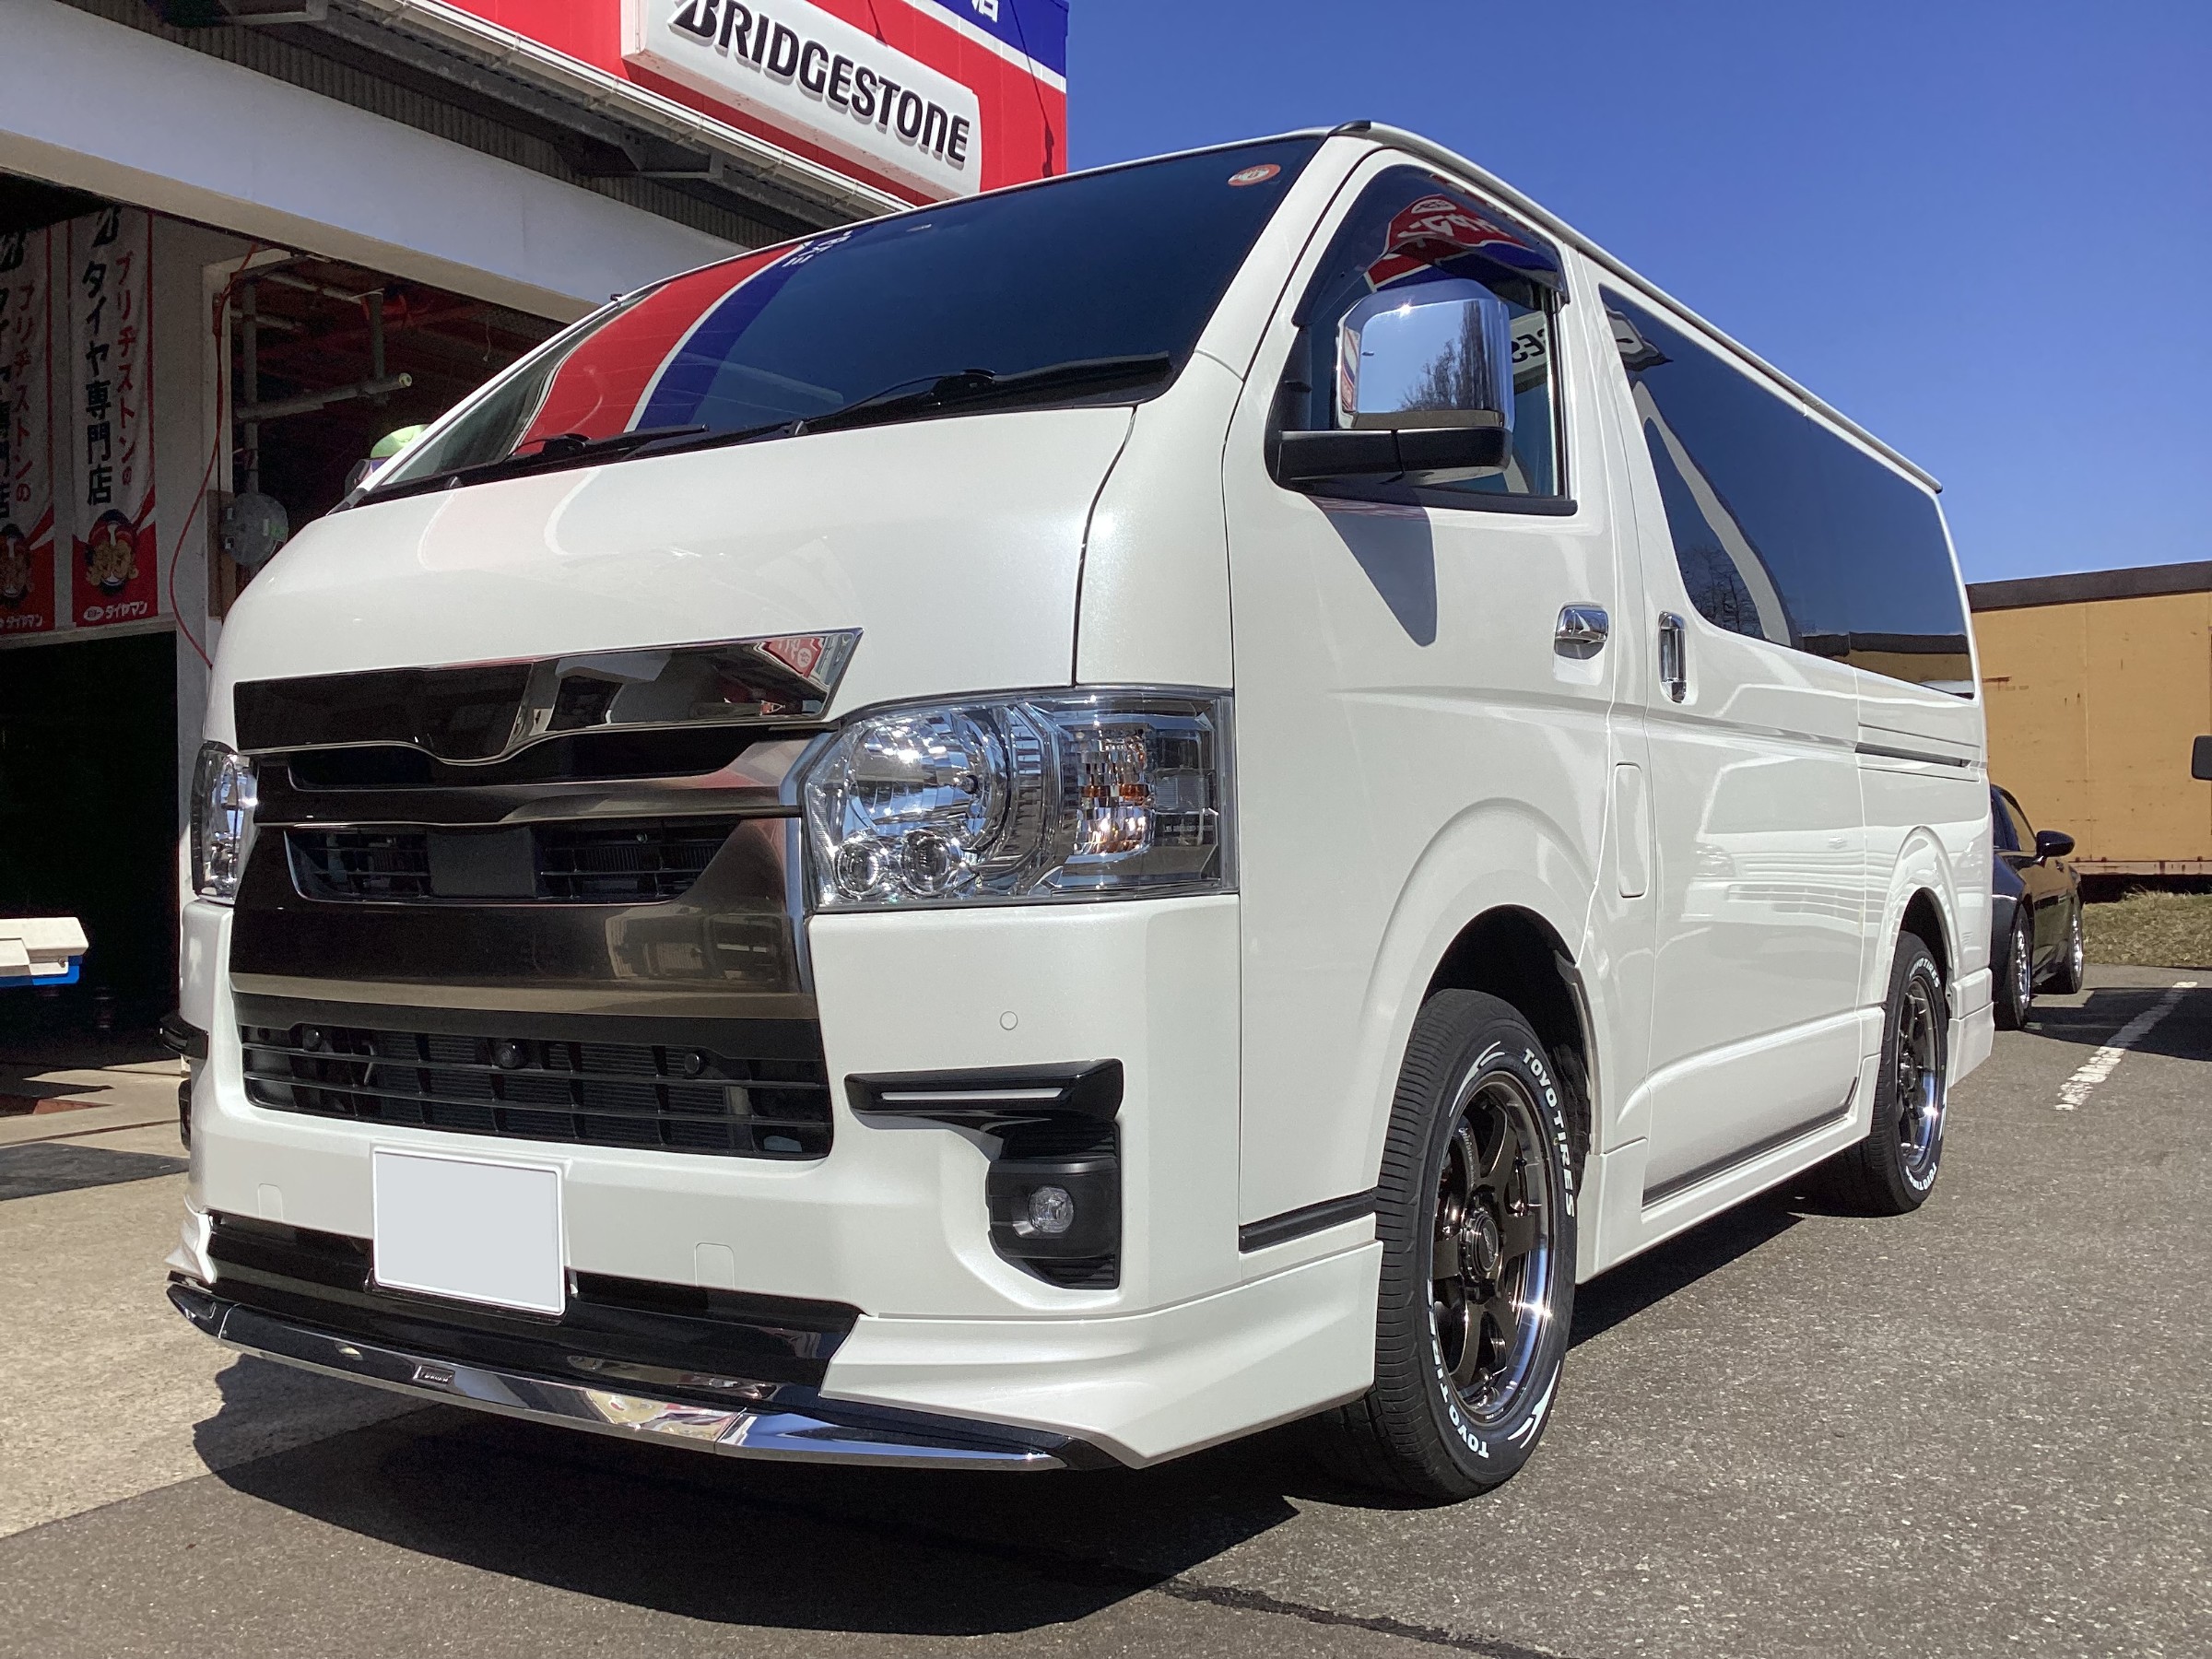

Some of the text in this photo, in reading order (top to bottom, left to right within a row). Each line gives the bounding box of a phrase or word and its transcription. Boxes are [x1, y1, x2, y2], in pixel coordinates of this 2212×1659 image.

[671, 0, 971, 163] BRIDGESTONE
[82, 260, 112, 506] タイヤ専門店
[1523, 1048, 1574, 1217] TOYO TIRES
[1449, 1404, 1489, 1459] TOYO
